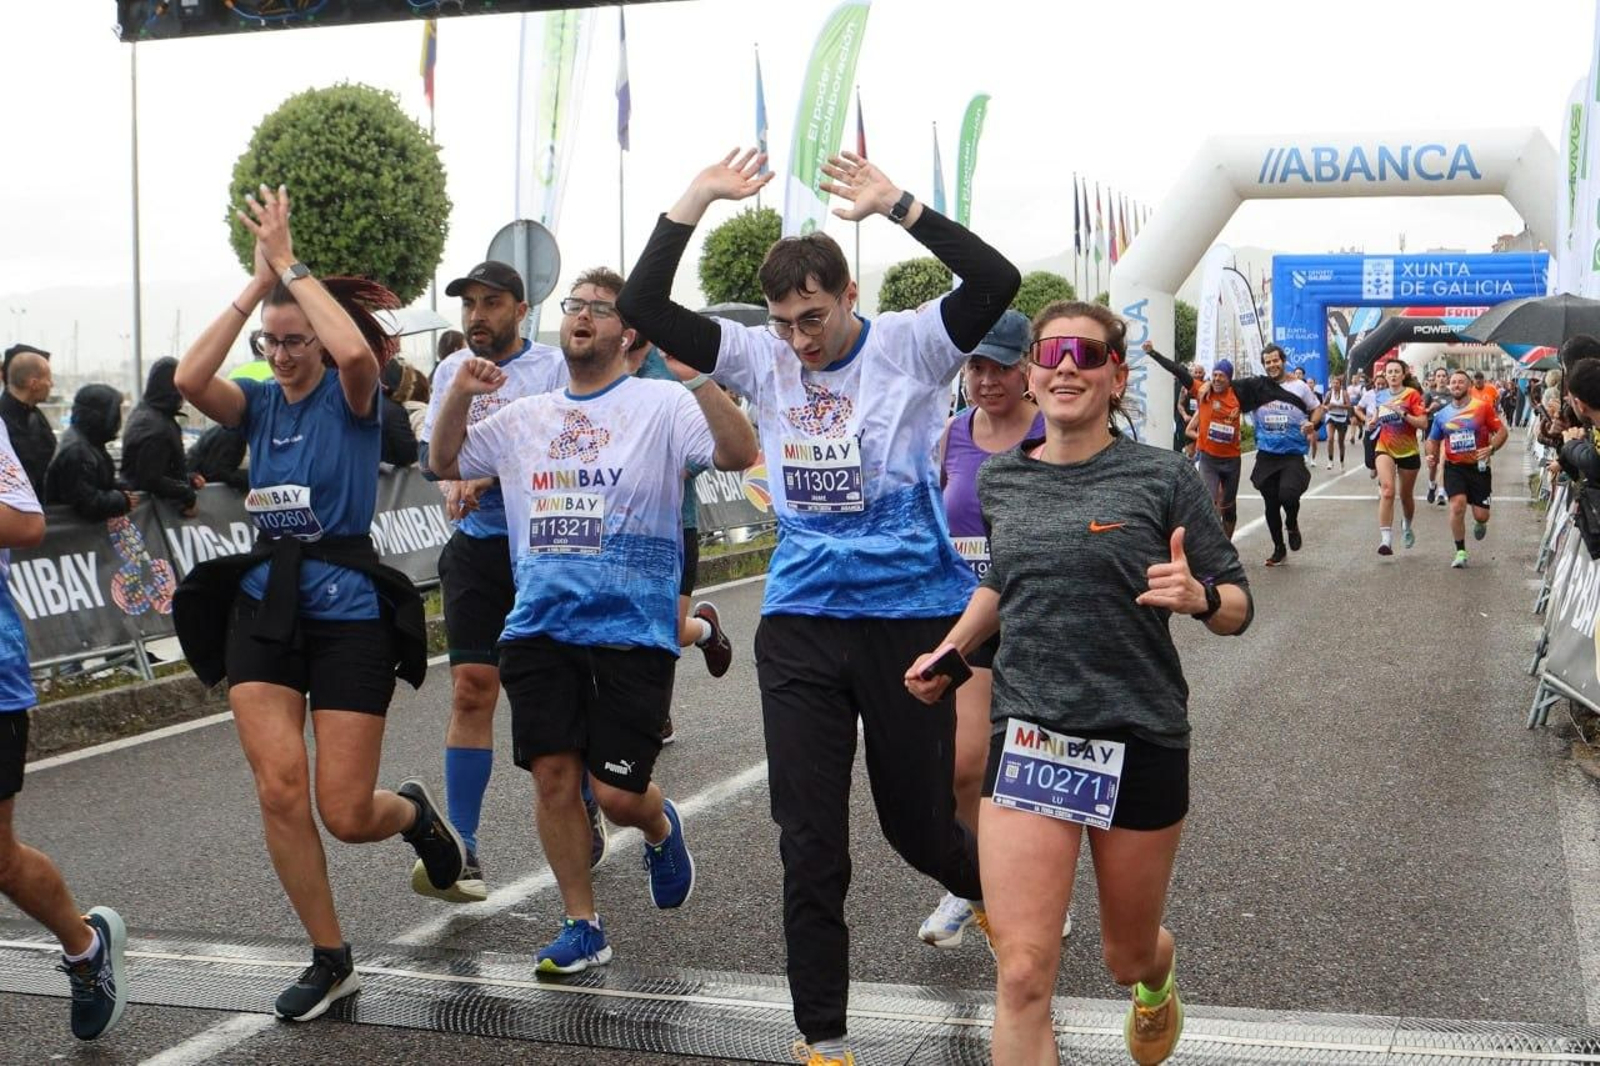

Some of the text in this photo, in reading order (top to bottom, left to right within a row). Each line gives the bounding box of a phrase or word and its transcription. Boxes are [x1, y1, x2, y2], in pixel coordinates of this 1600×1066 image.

[821, 22, 856, 145] colaboración
[807, 63, 831, 142] El poder
[1402, 262, 1471, 278] XUNTA
[1401, 280, 1514, 296] DE GALICIA
[784, 443, 851, 461] MINIBAY
[532, 468, 623, 490] MINIBAY
[795, 470, 850, 491] 11302
[248, 490, 302, 506] MINIBAY
[536, 497, 598, 512] MINIBAY
[260, 511, 307, 528] 10260
[540, 519, 590, 536] 11321
[1015, 727, 1114, 765] MINIBAY
[1024, 761, 1101, 800] 10271
[1052, 796, 1063, 804] LU
